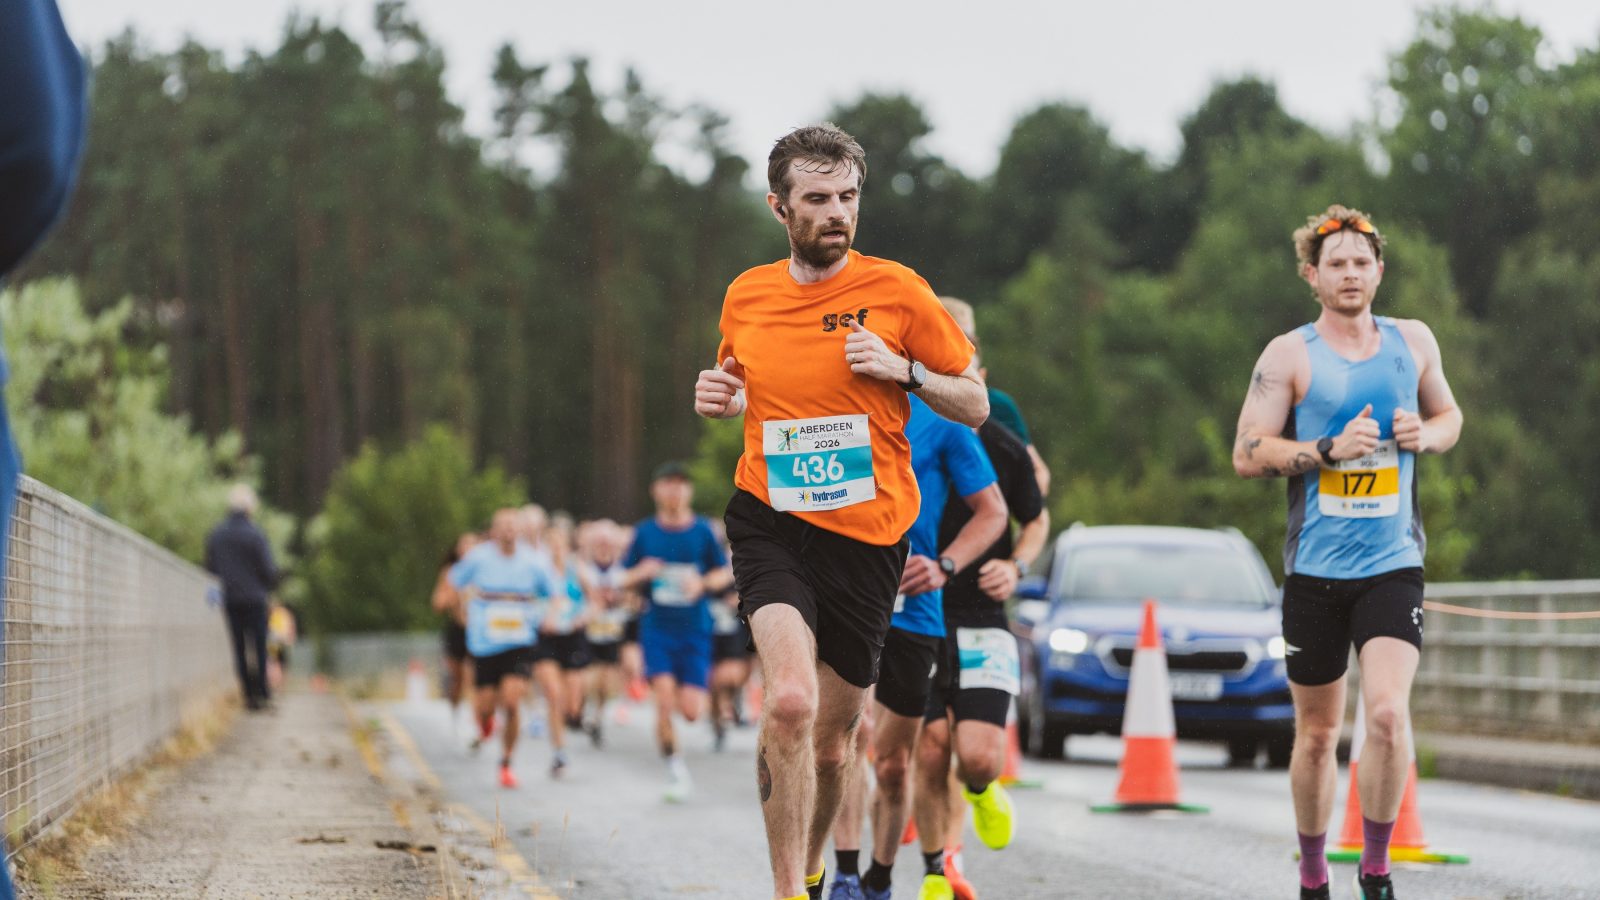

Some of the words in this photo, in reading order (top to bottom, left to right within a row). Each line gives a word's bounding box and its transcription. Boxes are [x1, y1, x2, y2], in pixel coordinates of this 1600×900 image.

[799, 422, 853, 435] ABERDEEN
[799, 433, 815, 441] HALF
[817, 431, 854, 440] MARATHON
[814, 439, 840, 449] 2026
[792, 453, 845, 484] 436
[1343, 472, 1377, 495] 177
[812, 488, 848, 502] hydrasun
